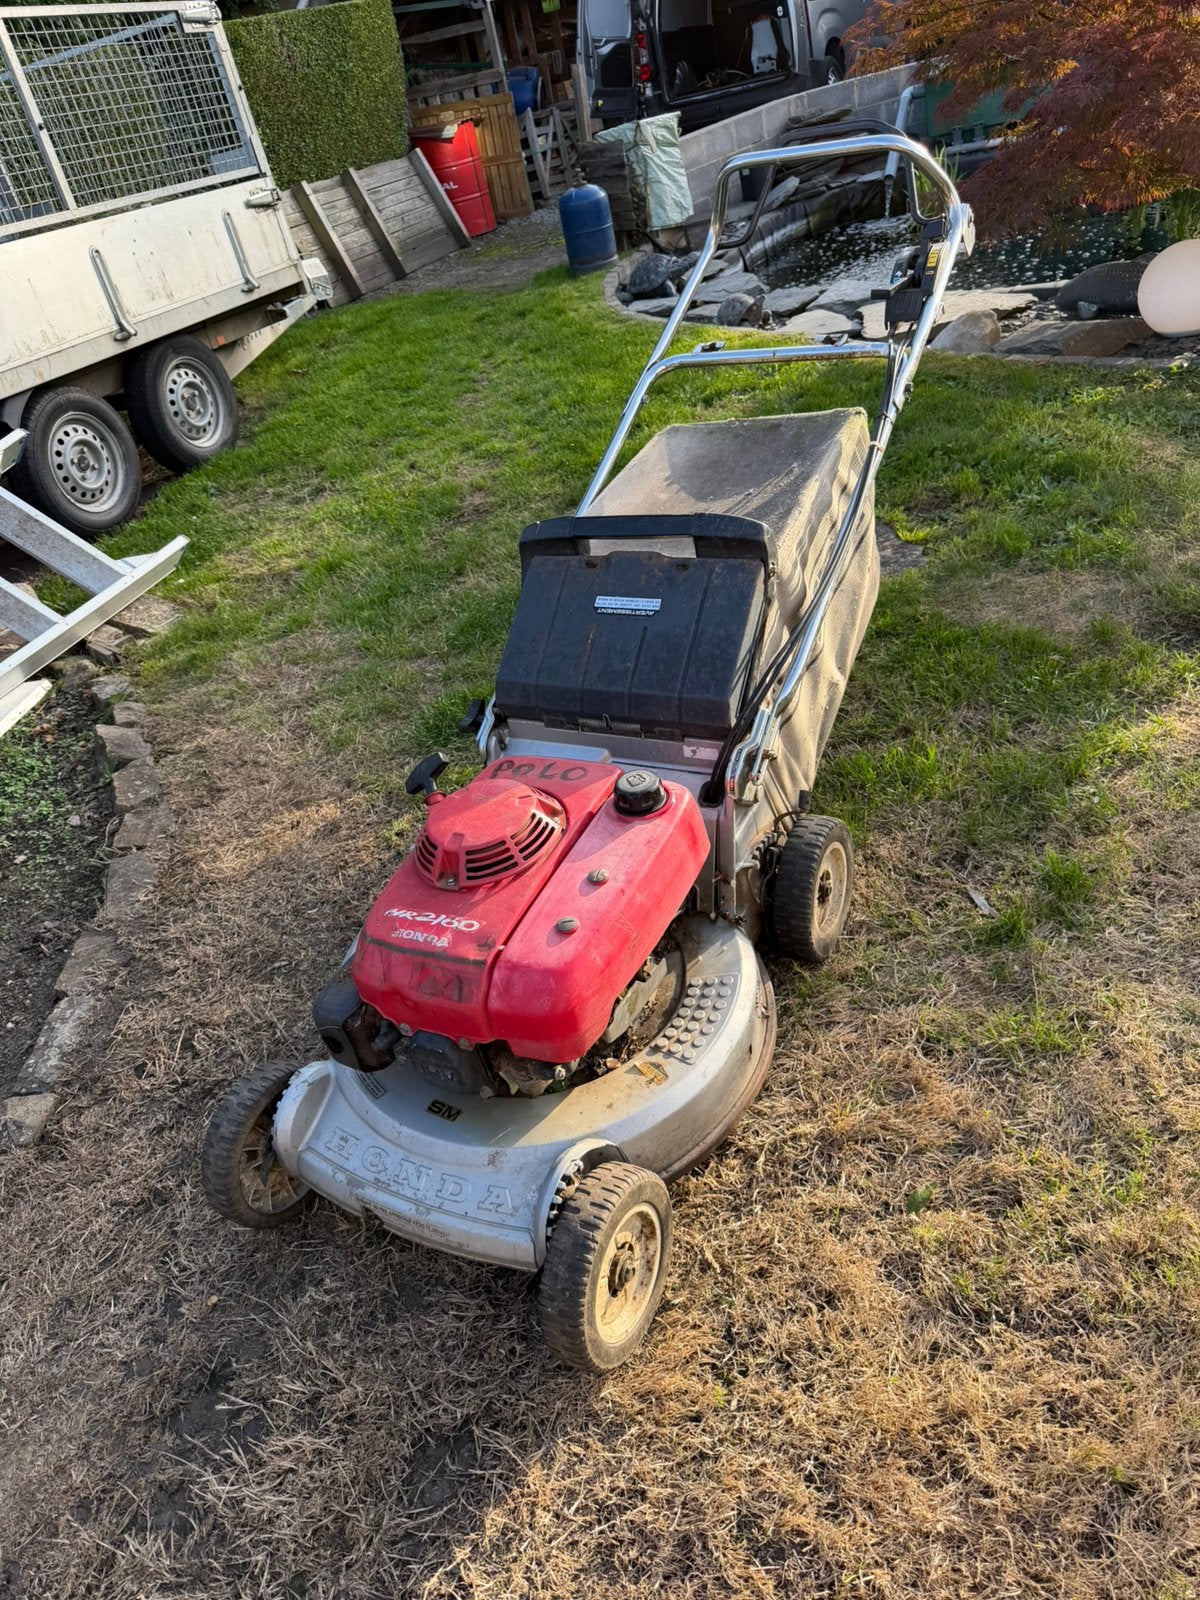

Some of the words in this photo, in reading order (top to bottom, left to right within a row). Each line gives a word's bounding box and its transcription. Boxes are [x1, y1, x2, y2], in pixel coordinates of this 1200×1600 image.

[596, 608, 655, 616] AVERTISSEMENT
[490, 759, 588, 781] POLO
[427, 1100, 462, 1122] SM
[325, 1127, 517, 1217] HONDA
